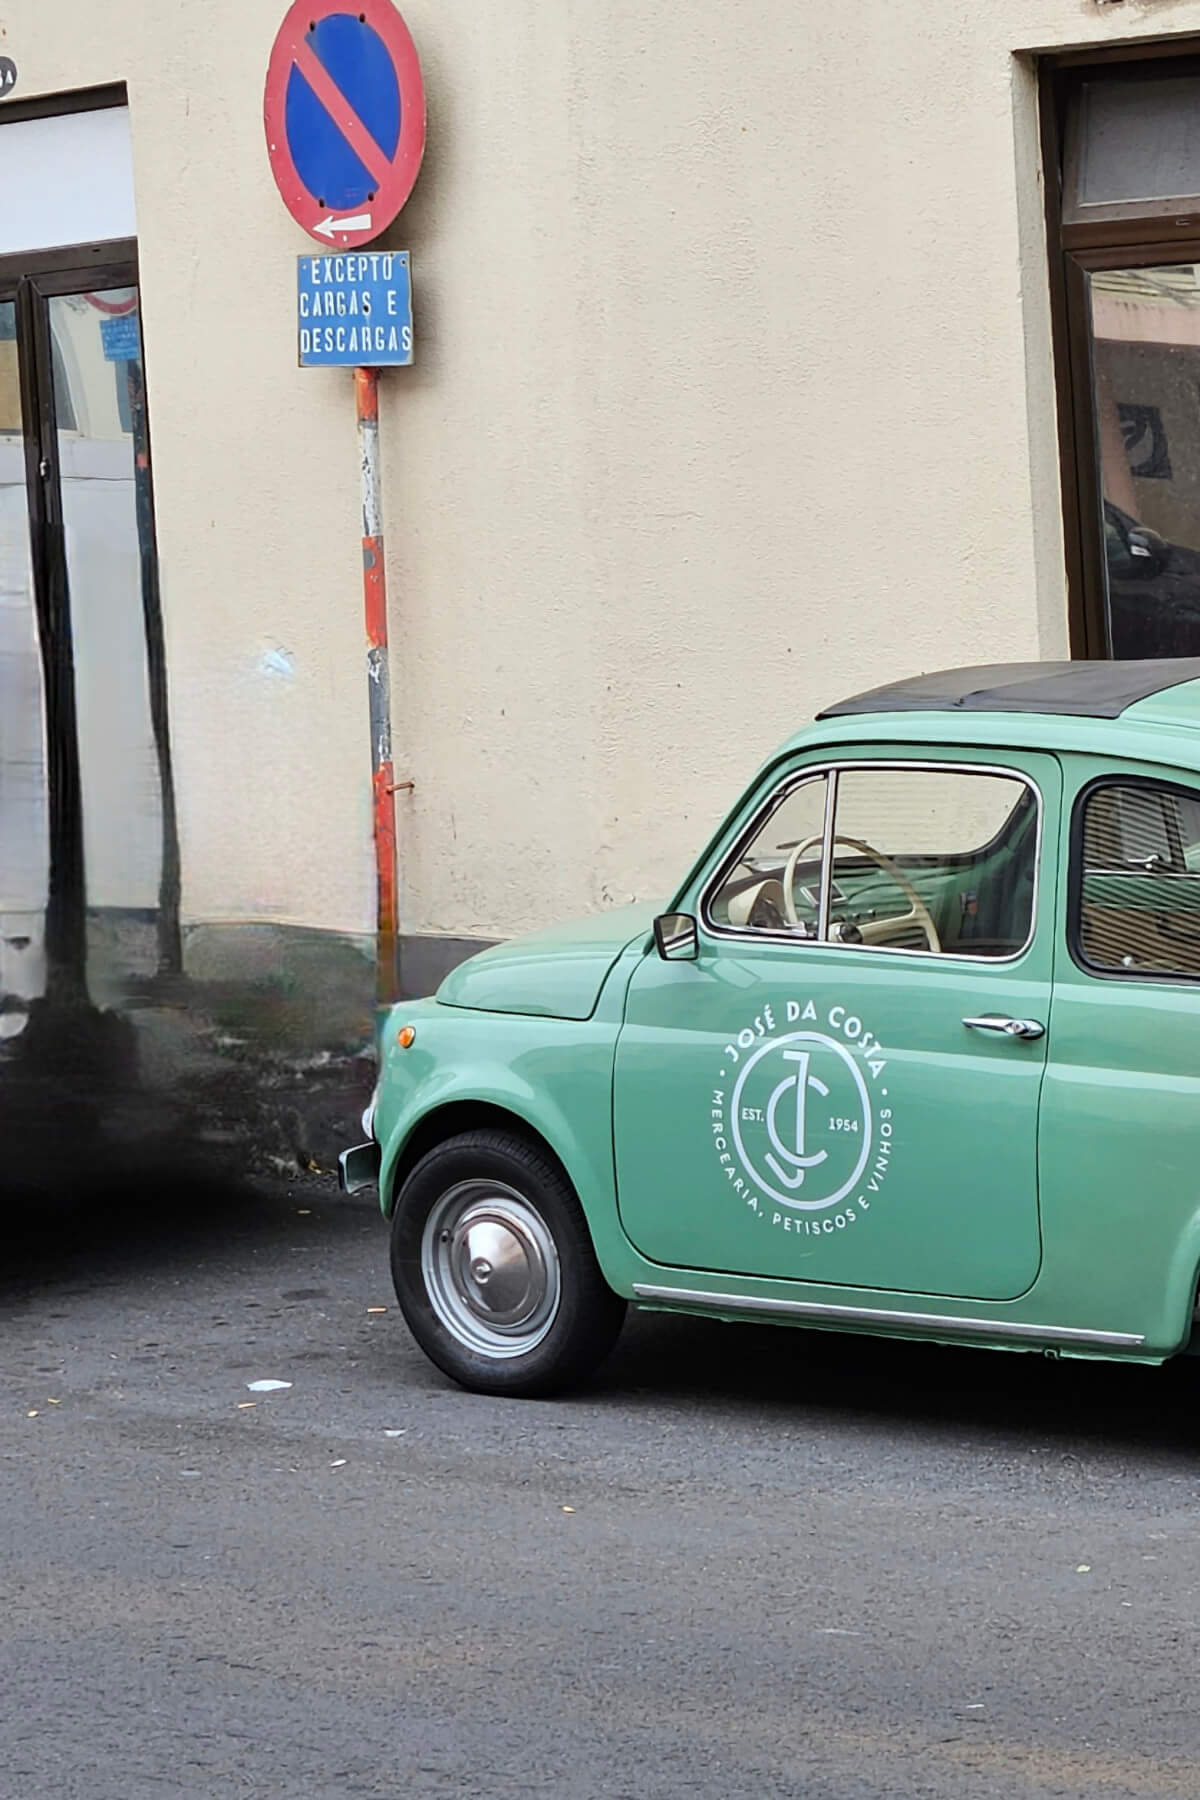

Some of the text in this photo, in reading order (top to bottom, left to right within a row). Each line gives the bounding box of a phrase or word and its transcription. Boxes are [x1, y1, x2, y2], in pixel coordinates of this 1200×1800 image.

[312, 256, 392, 284] EXCEPTO
[300, 290, 397, 317] CARGAS E
[301, 326, 411, 353] DESCARGAS
[725, 1000, 887, 1079] JOSÉ DA COSTA
[742, 1107, 765, 1122] EST.
[828, 1117, 858, 1132] 1954
[711, 1090, 892, 1235] MERCEARIA, PETISCOS E VINHOS
